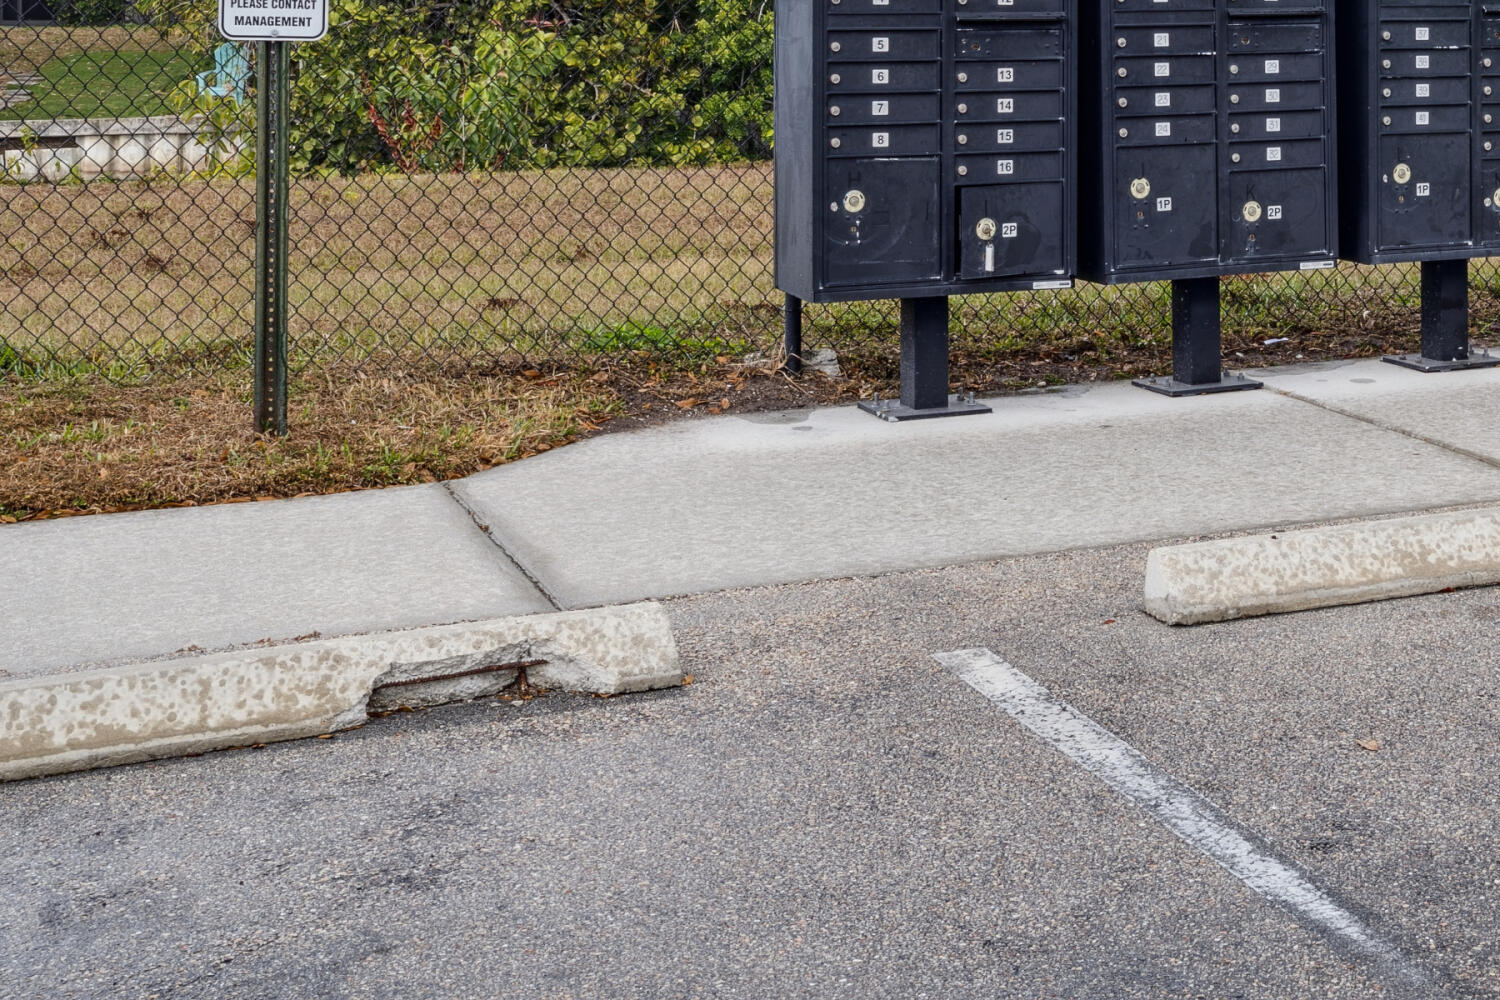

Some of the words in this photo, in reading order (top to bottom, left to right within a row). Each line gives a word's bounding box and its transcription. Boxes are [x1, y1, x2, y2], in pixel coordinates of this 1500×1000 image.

[234, 16, 312, 28] MANAGEMENT
[877, 40, 884, 50] 5
[1156, 34, 1168, 46] 21
[1156, 64, 1168, 74] 22
[1266, 62, 1278, 72] 29
[877, 72, 884, 82] 6
[999, 70, 1012, 80] 13
[1156, 94, 1168, 104] 23
[876, 102, 884, 112] 7
[999, 100, 1012, 110] 14
[1156, 124, 1168, 134] 24
[1268, 120, 1278, 130] 31
[877, 134, 884, 144] 8
[999, 132, 1012, 140] 15
[999, 162, 1012, 172] 16
[1418, 185, 1428, 194] 1P
[1158, 199, 1170, 209] 1P
[1269, 208, 1280, 217] 2P
[1003, 224, 1016, 236] 2P
